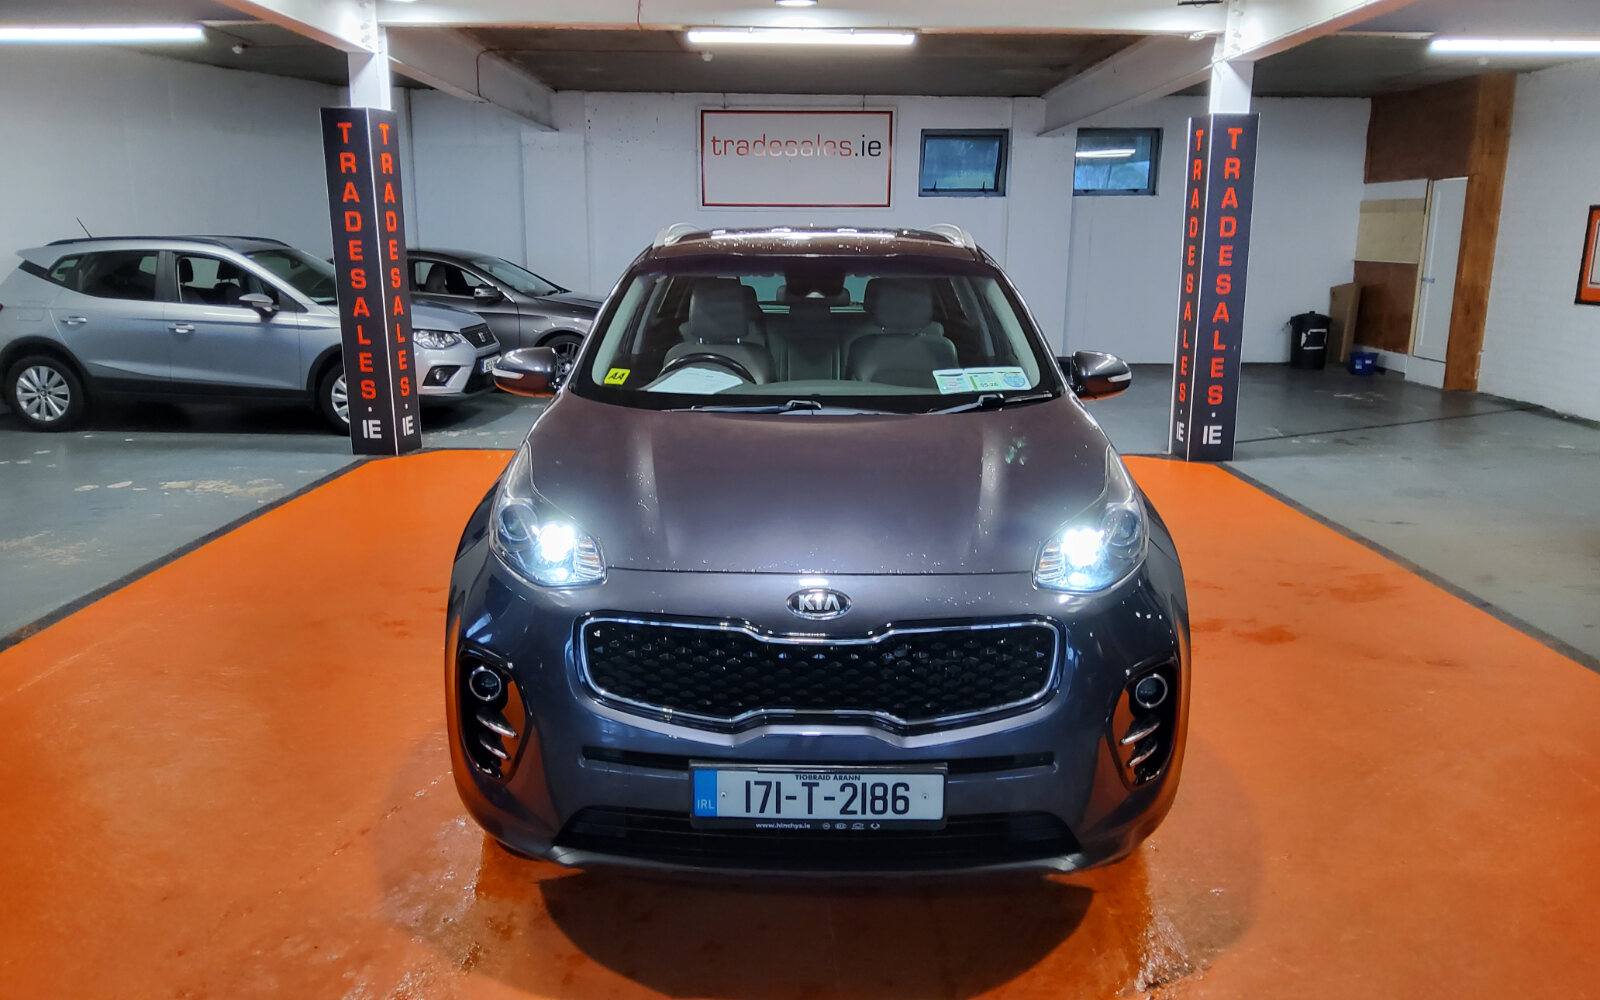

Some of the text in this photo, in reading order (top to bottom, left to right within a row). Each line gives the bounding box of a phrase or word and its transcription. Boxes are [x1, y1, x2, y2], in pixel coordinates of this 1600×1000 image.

[711, 133, 882, 157] tradesales.ie
[799, 594, 840, 611] KIA
[697, 799, 715, 810] IRL
[745, 780, 910, 816] 171-T-2186
